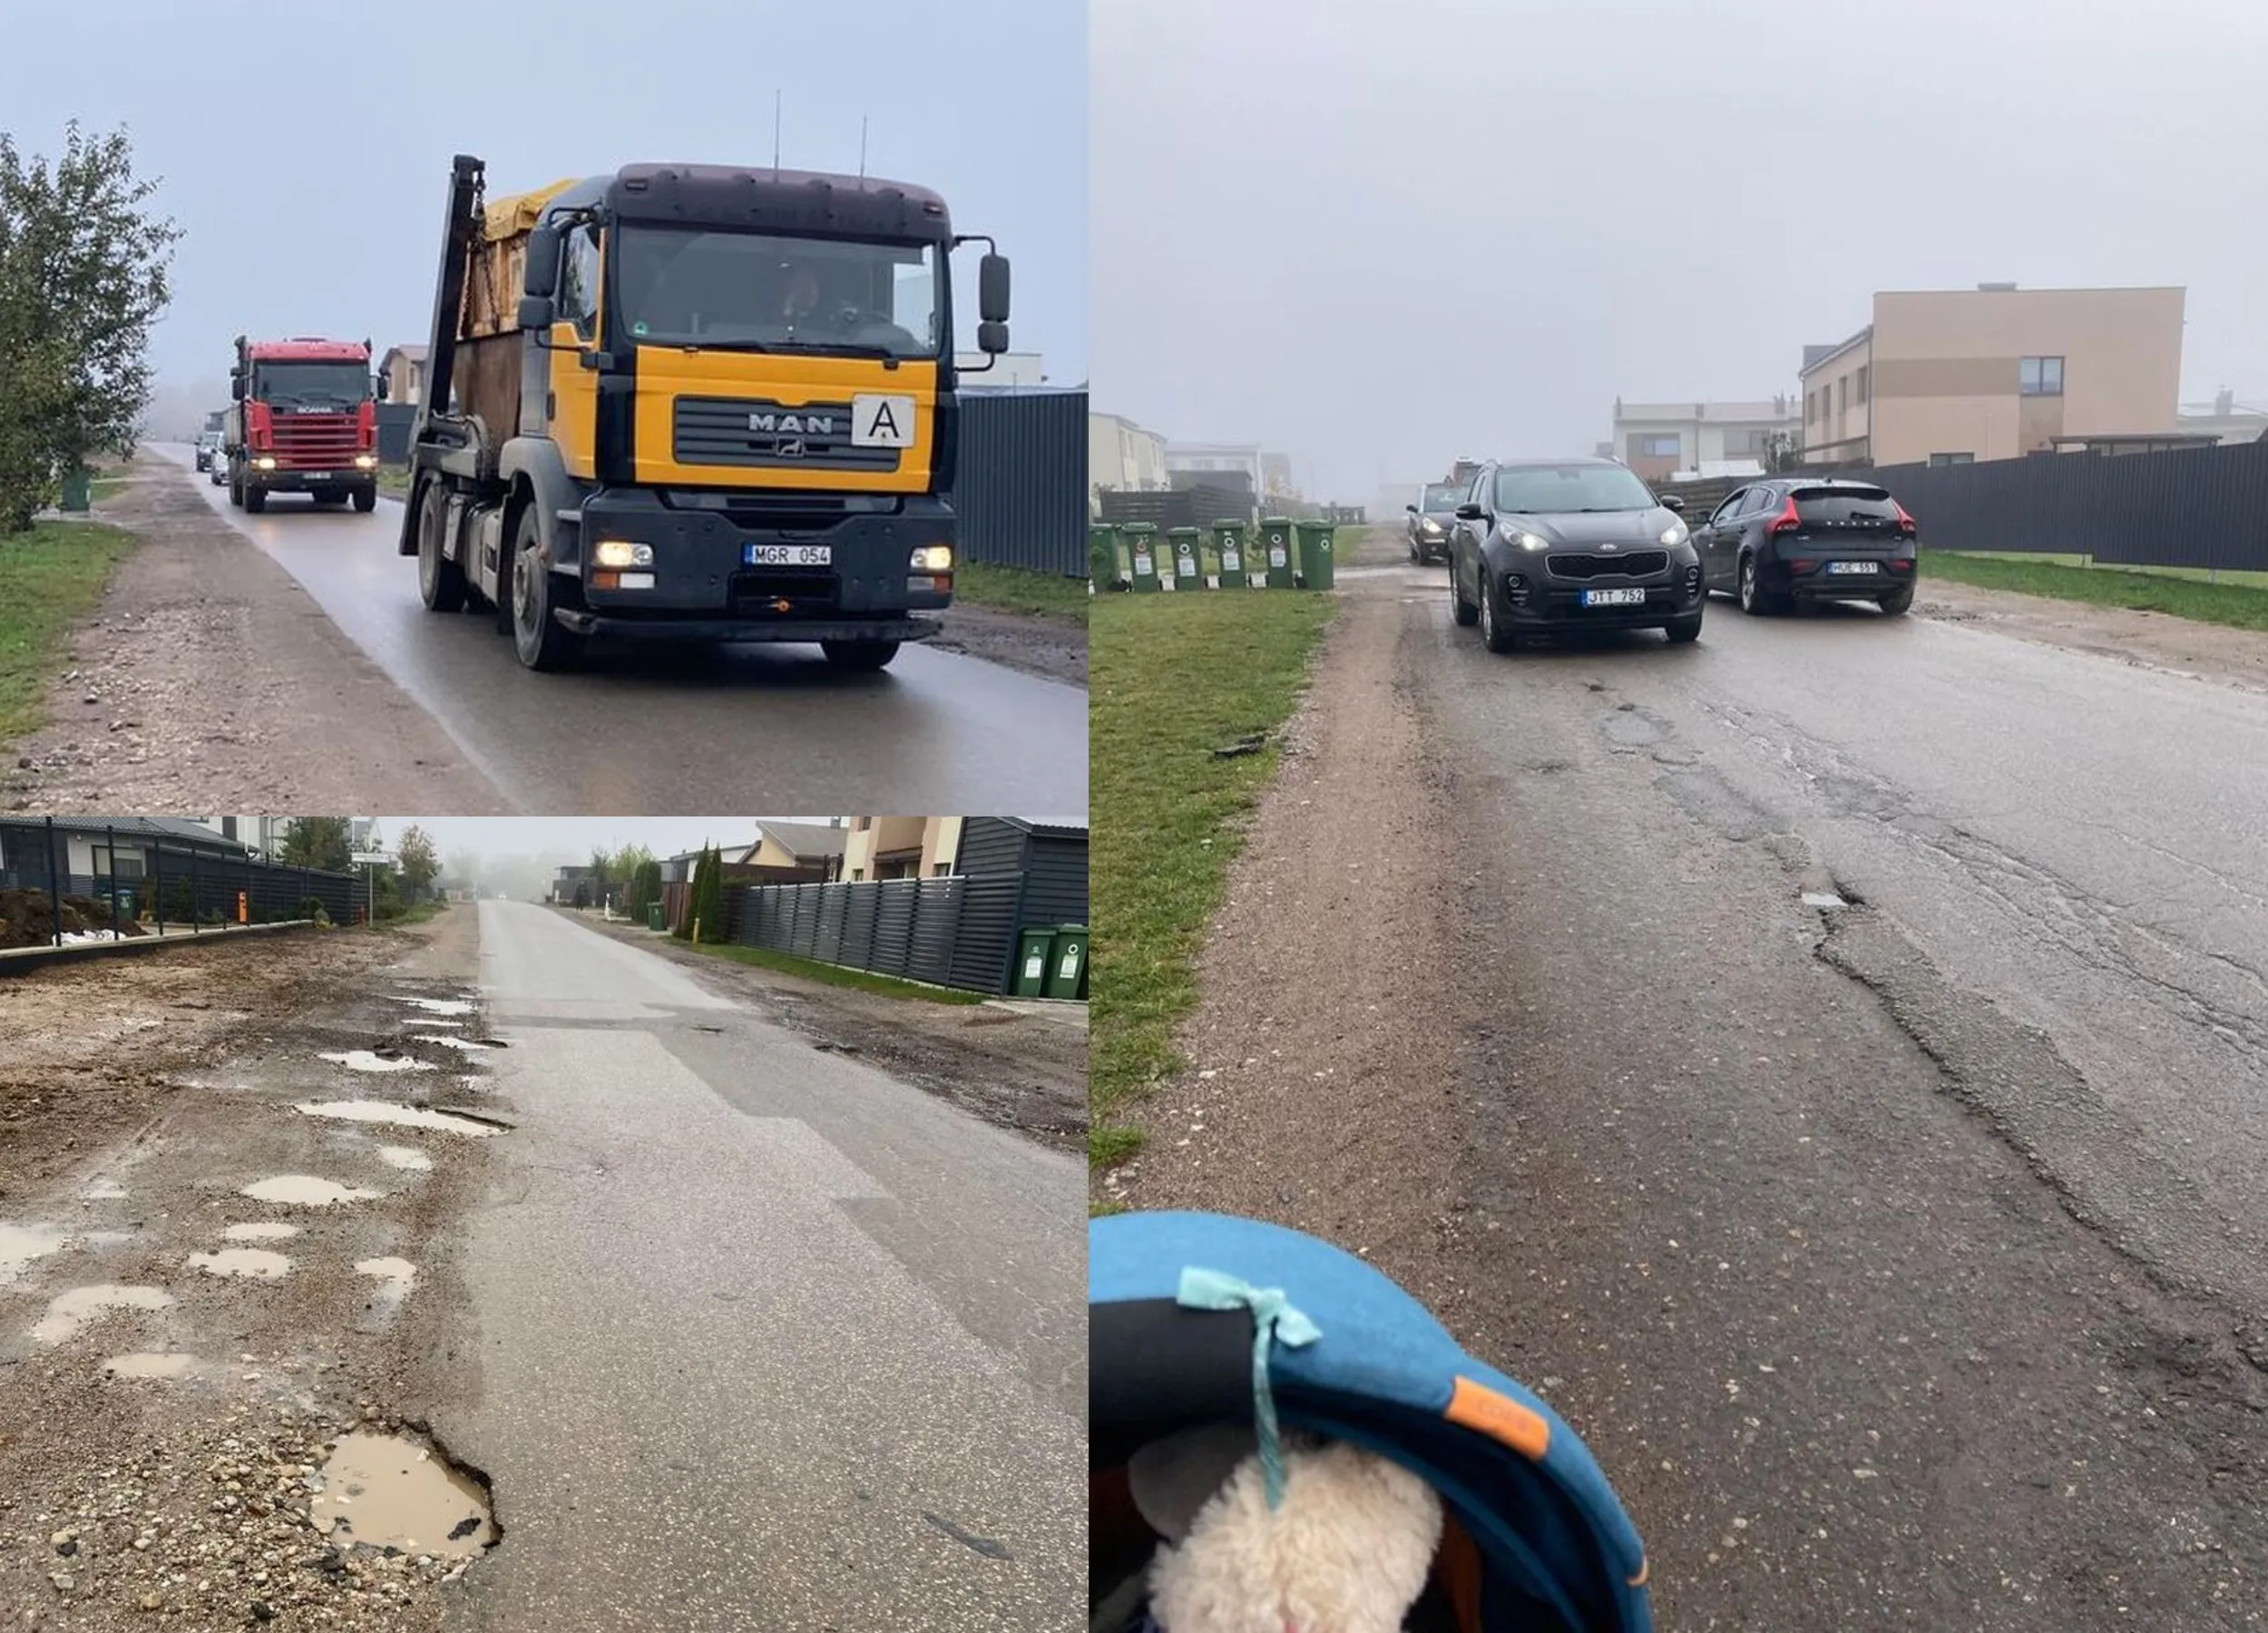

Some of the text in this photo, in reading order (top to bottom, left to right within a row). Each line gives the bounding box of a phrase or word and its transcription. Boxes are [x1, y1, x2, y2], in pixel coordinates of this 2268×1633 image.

[748, 414, 832, 433] MAN
[868, 400, 899, 438] A
[755, 547, 827, 562] MGR 054
[1589, 590, 1643, 602] JTT 752
